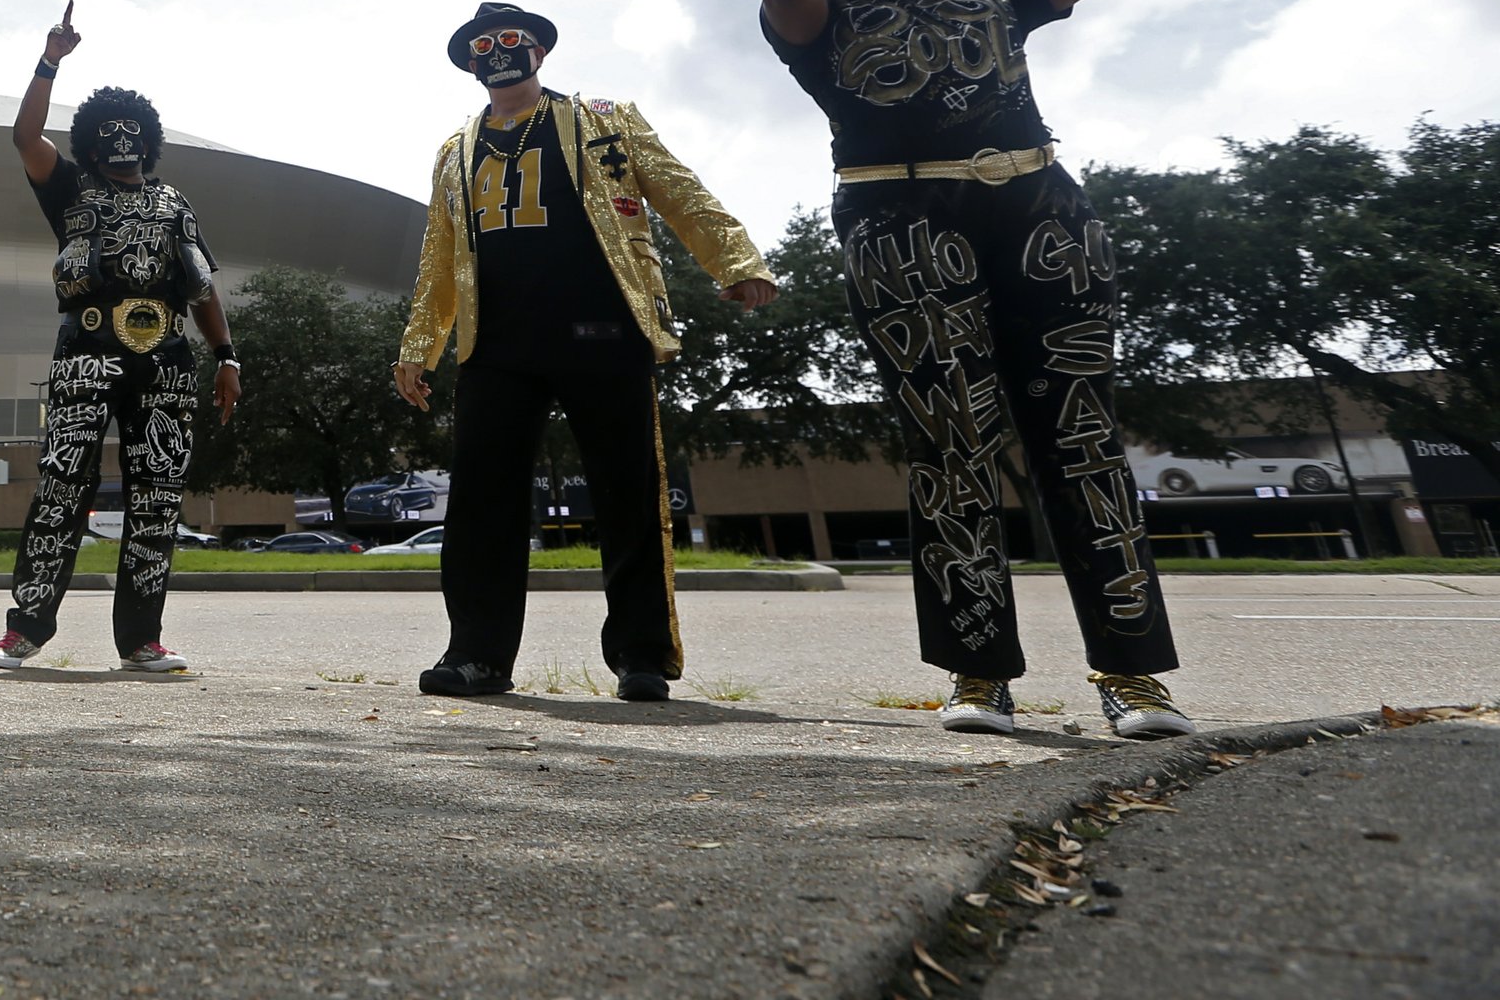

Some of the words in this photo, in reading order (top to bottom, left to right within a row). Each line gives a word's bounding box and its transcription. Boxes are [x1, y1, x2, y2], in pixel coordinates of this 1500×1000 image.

[593, 102, 611, 112] NFL
[473, 147, 549, 233] 41
[849, 217, 978, 309] WHO
[868, 287, 995, 373] DAT
[51, 354, 124, 381] PAYTONS
[53, 377, 112, 397] OFFENSE
[141, 392, 178, 408] HARD
[126, 442, 151, 457] DAVIS
[1412, 439, 1471, 457] Brea
[909, 433, 1004, 520] DAT
[34, 504, 65, 528] 28
[26, 530, 77, 558] COOK
[951, 608, 974, 633] CAN
[970, 599, 992, 624] YOU
[961, 631, 987, 652] DIG
